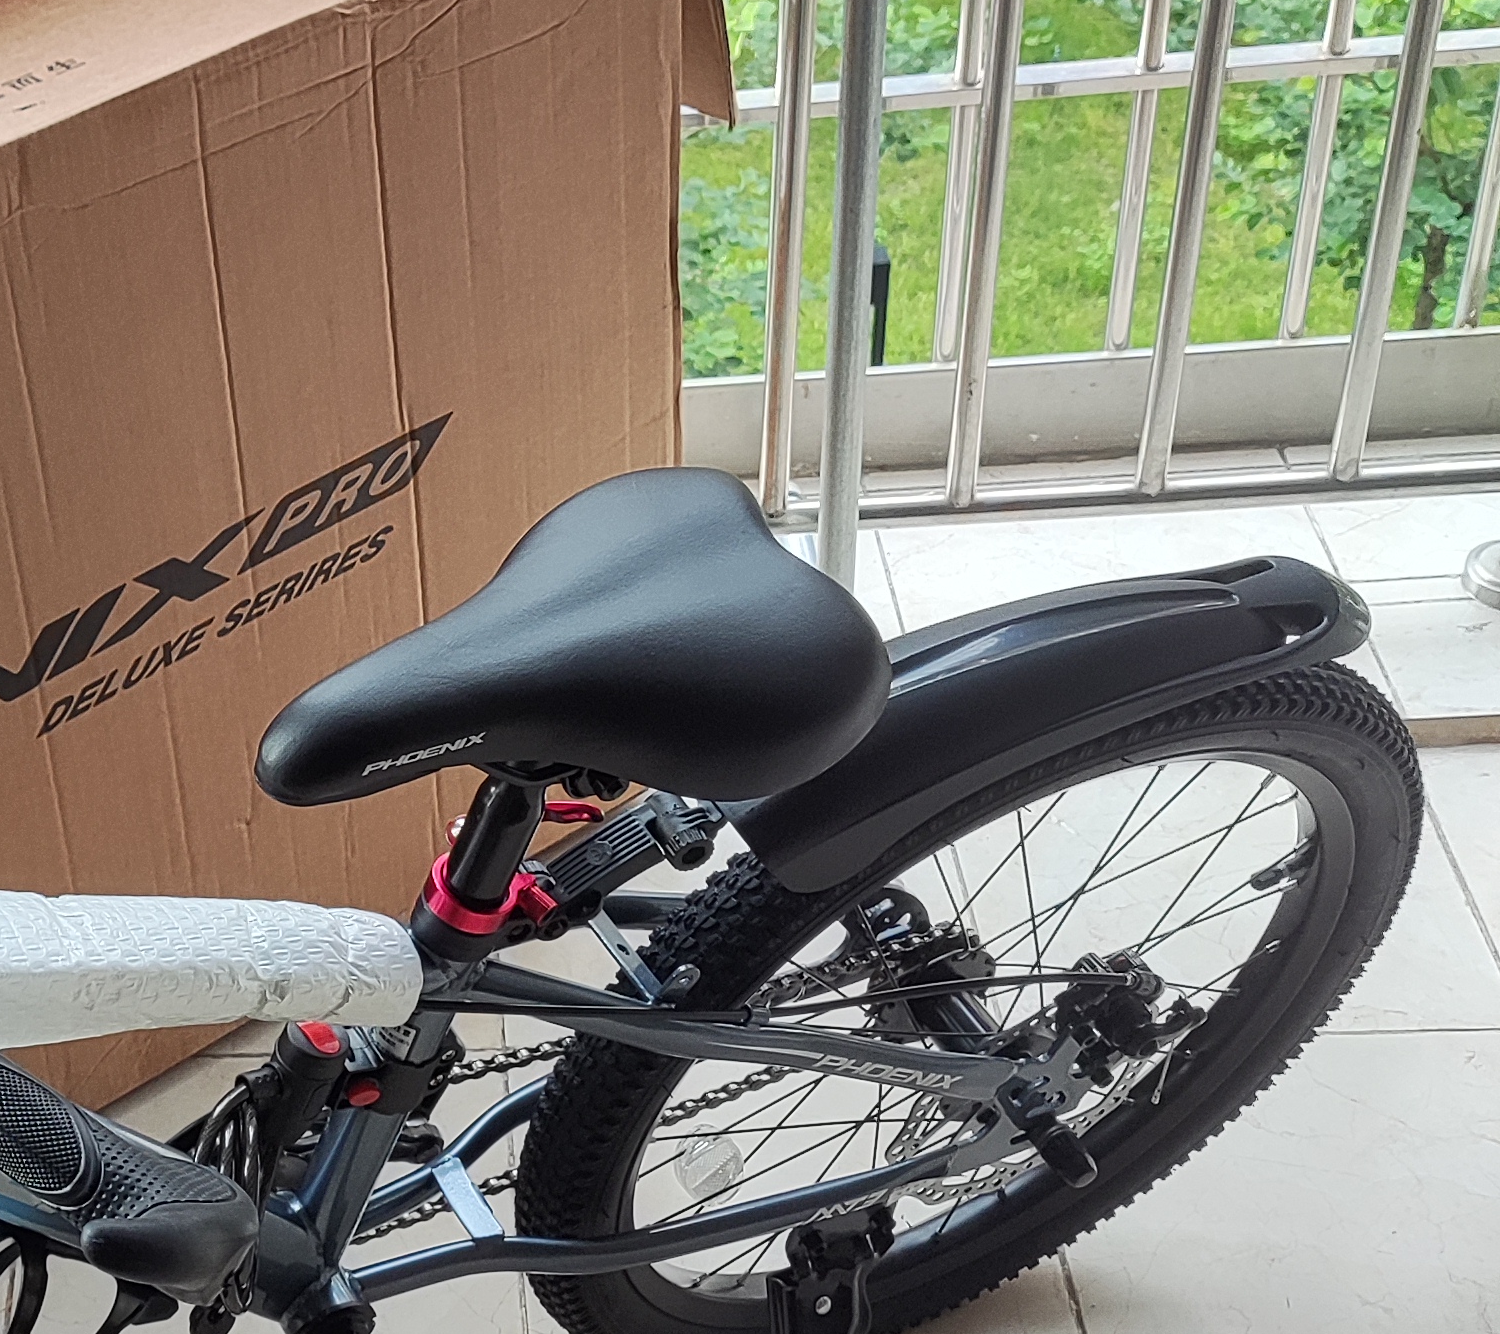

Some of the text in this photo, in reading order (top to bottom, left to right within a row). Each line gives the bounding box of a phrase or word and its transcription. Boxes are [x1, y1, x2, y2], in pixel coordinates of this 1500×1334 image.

[37, 525, 393, 738] DELUXE SERIRES
[361, 731, 487, 777] PHOENIX
[812, 1054, 965, 1090] PHOENIX
